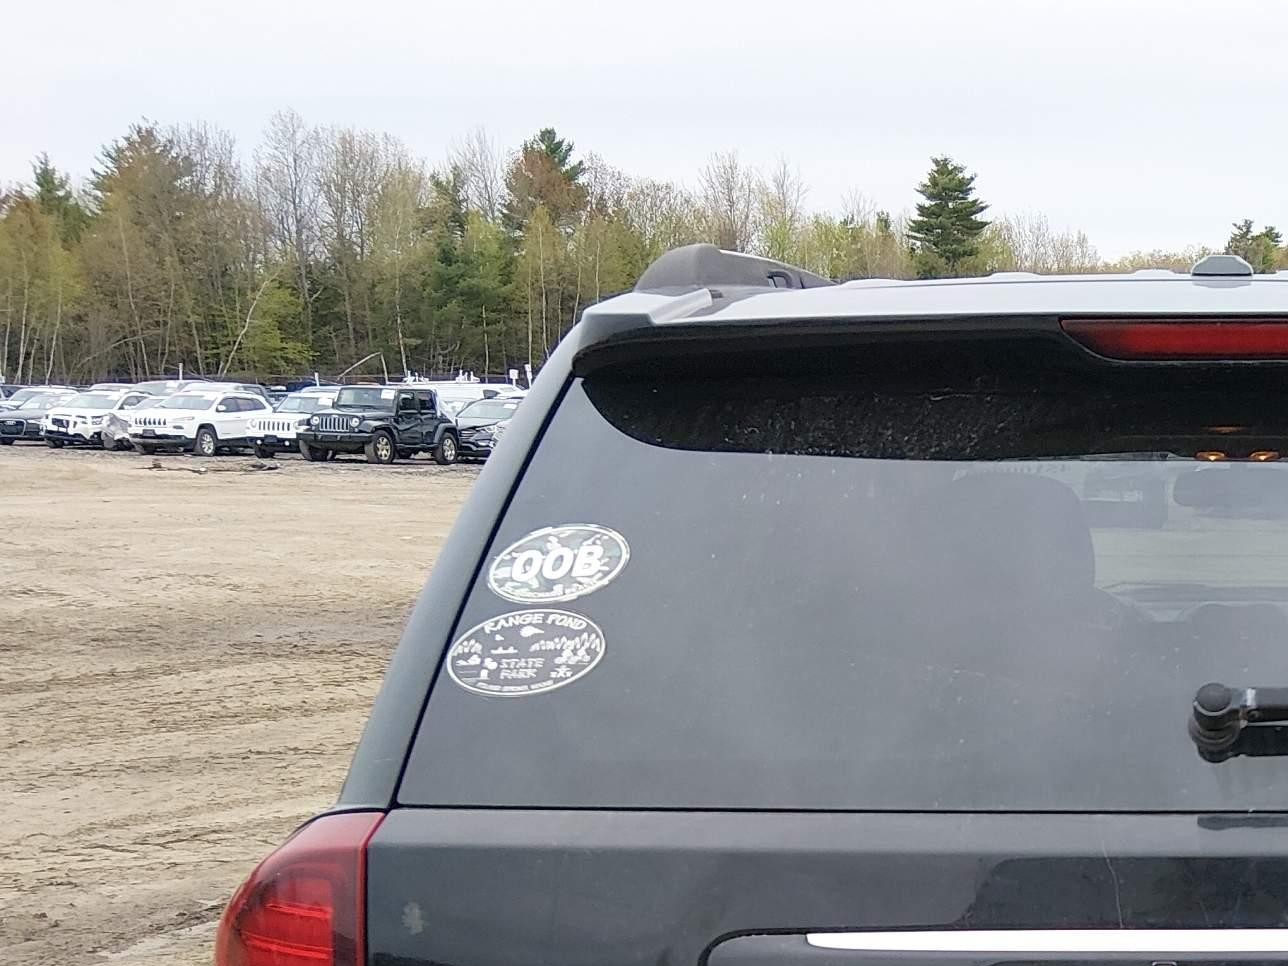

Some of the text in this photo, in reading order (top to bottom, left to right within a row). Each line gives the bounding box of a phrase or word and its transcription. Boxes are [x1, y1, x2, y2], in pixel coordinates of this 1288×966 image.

[483, 613, 588, 634] RANGE POND
[499, 658, 545, 669] STATE
[500, 669, 538, 679] PARK
